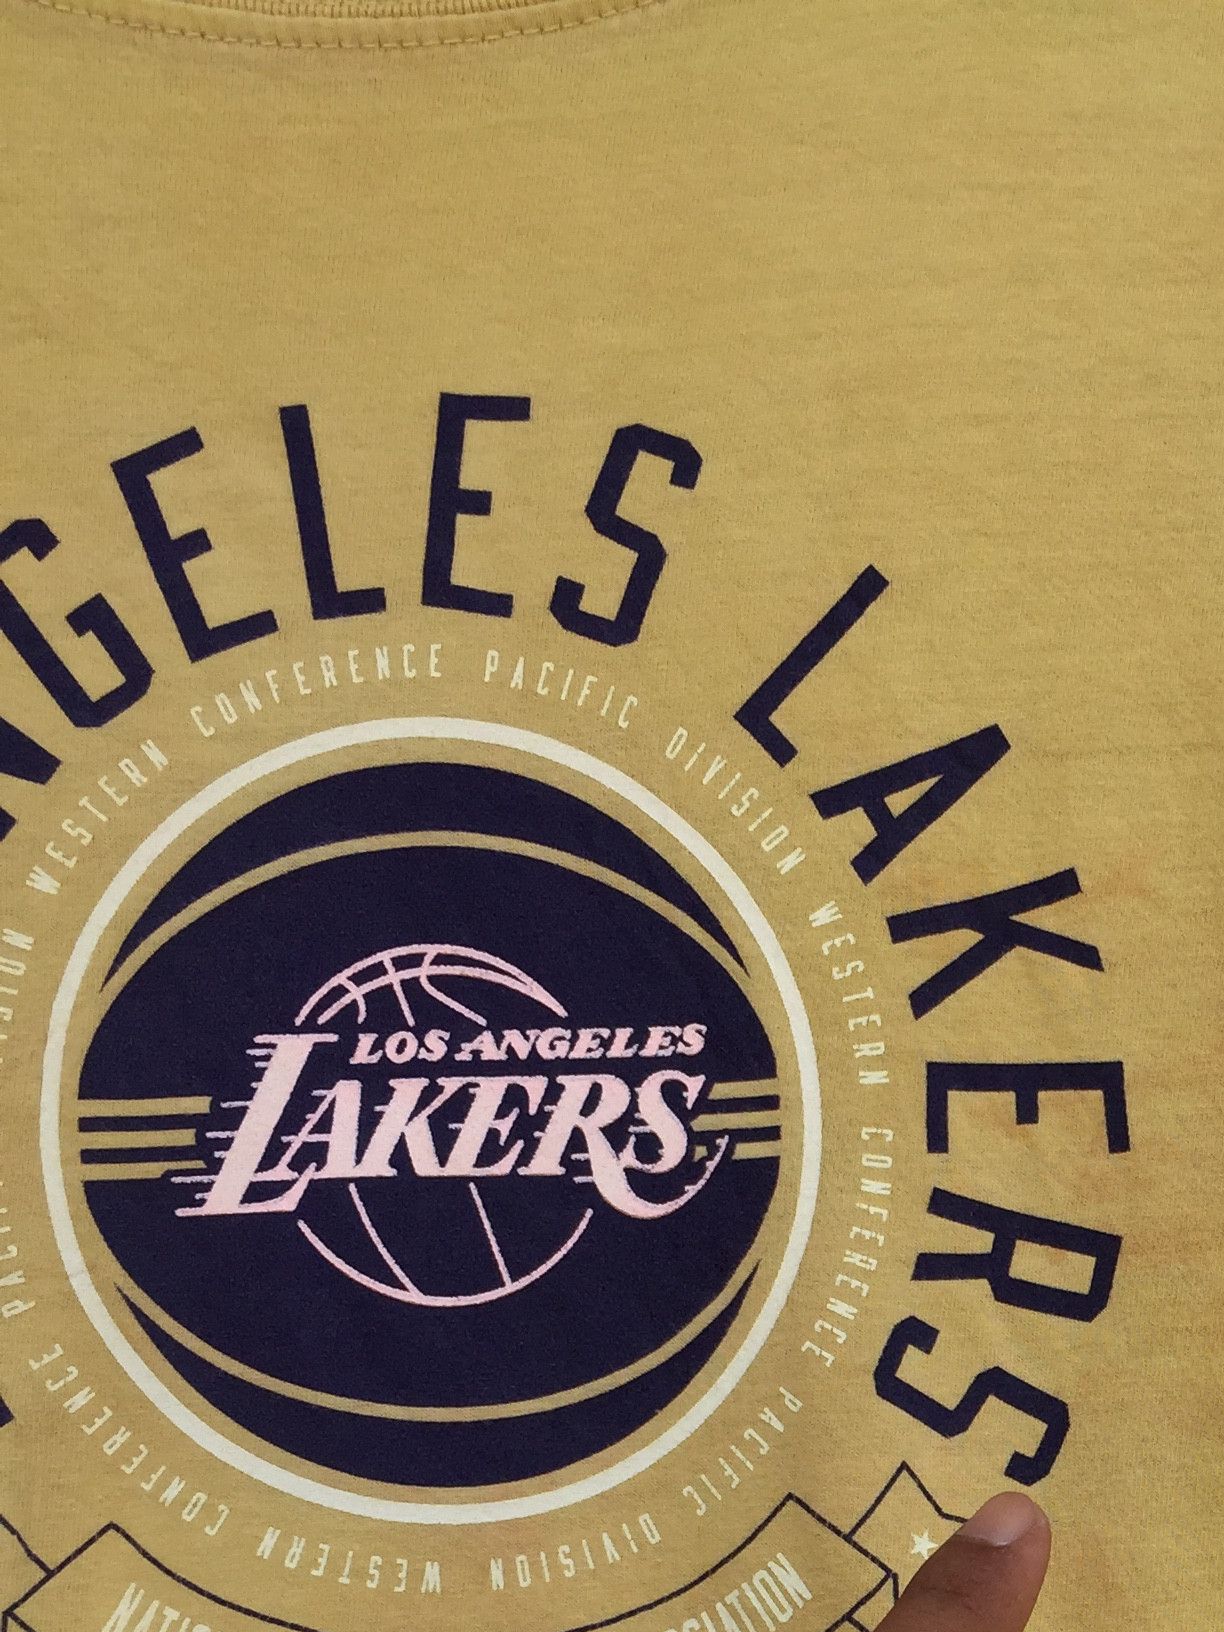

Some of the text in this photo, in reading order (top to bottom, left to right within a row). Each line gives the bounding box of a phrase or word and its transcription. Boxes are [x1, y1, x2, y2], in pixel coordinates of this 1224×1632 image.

[190, 643, 442, 738] CONFERENCE
[484, 650, 638, 729] PACIFIC
[26, 738, 169, 896] WESTERN
[665, 727, 806, 876] DIVISION
[0, 392, 1130, 1486] GELES LAKERS
[809, 901, 890, 1086] WESTERN
[349, 1023, 708, 1064] LOS ANGELES
[171, 1033, 729, 1219] LAKERS
[801, 1126, 893, 1368] CONFERENCE
[31, 1343, 230, 1537] CONFERENCE
[682, 1386, 803, 1516] PACIFIC
[256, 1526, 442, 1594] WESTERN
[490, 1512, 661, 1592] DIVISION
